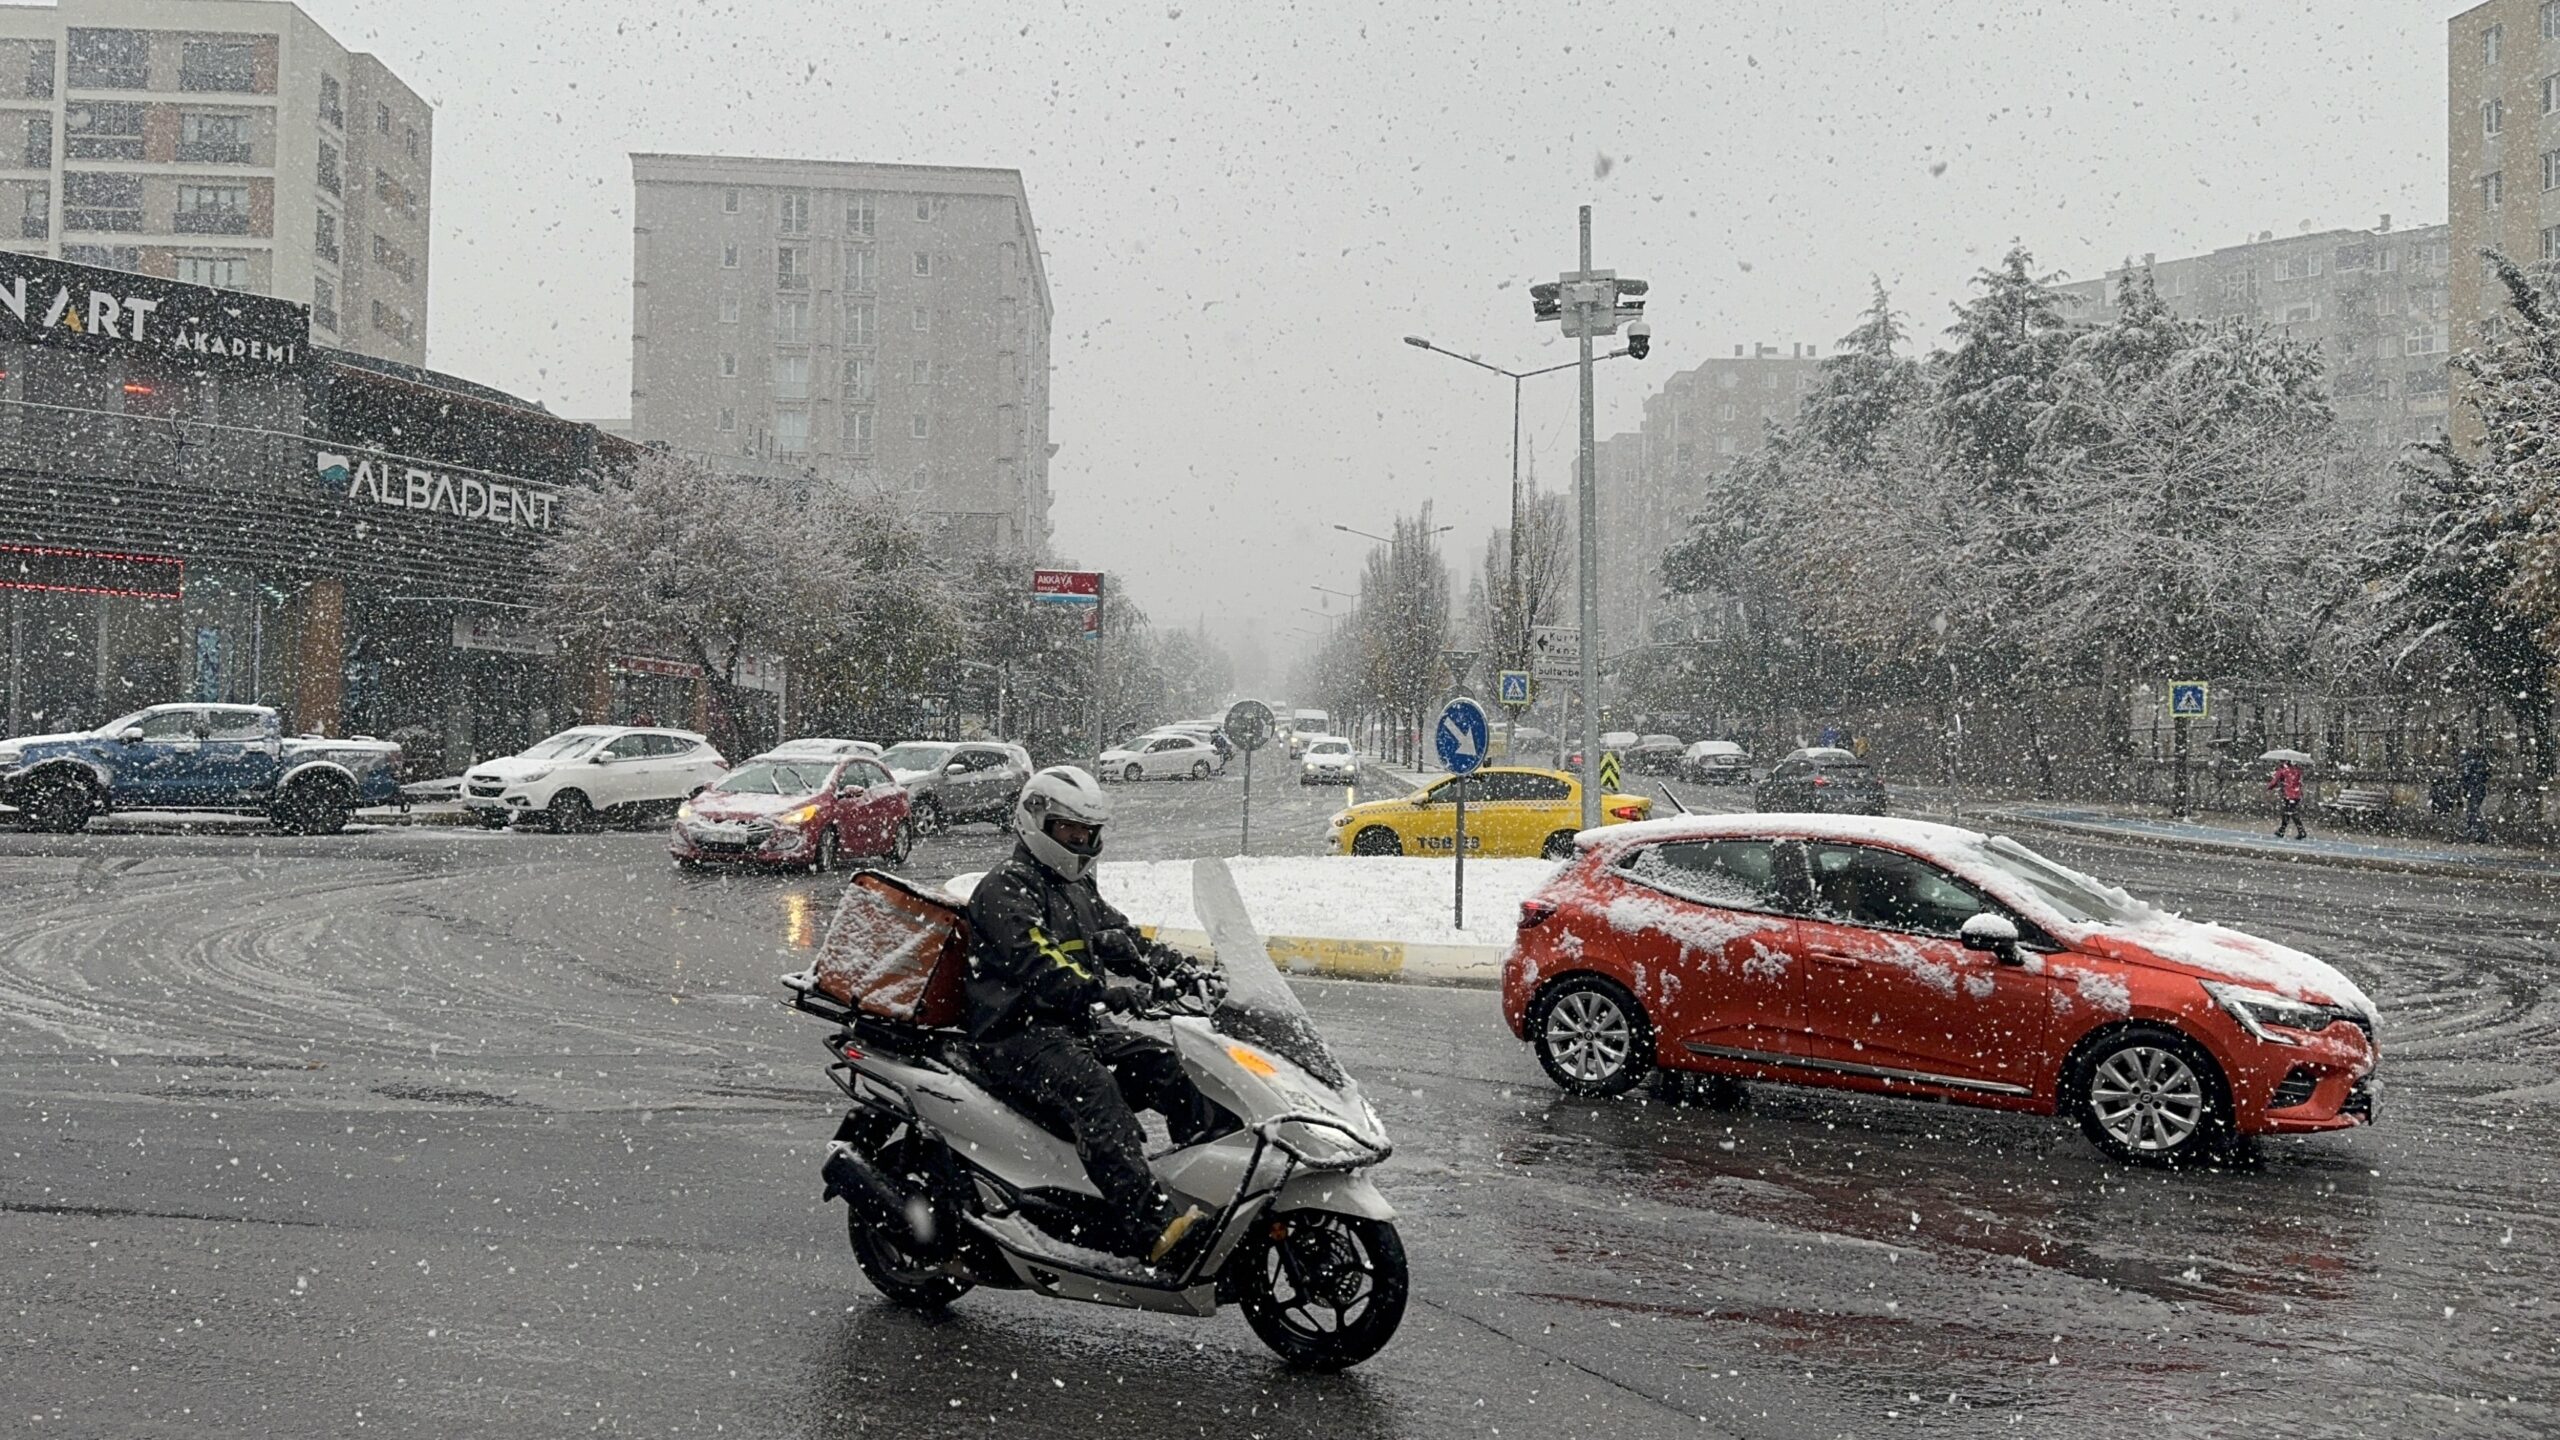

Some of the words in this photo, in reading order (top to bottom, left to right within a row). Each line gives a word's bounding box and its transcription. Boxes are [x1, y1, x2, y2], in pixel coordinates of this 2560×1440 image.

[43, 285, 157, 342] ART
[350, 461, 558, 529] ALBADENT
[1037, 574, 1072, 585] AKKAYA
[1549, 632, 1580, 642] Kurk
[1538, 666, 1580, 677] Sultabe
